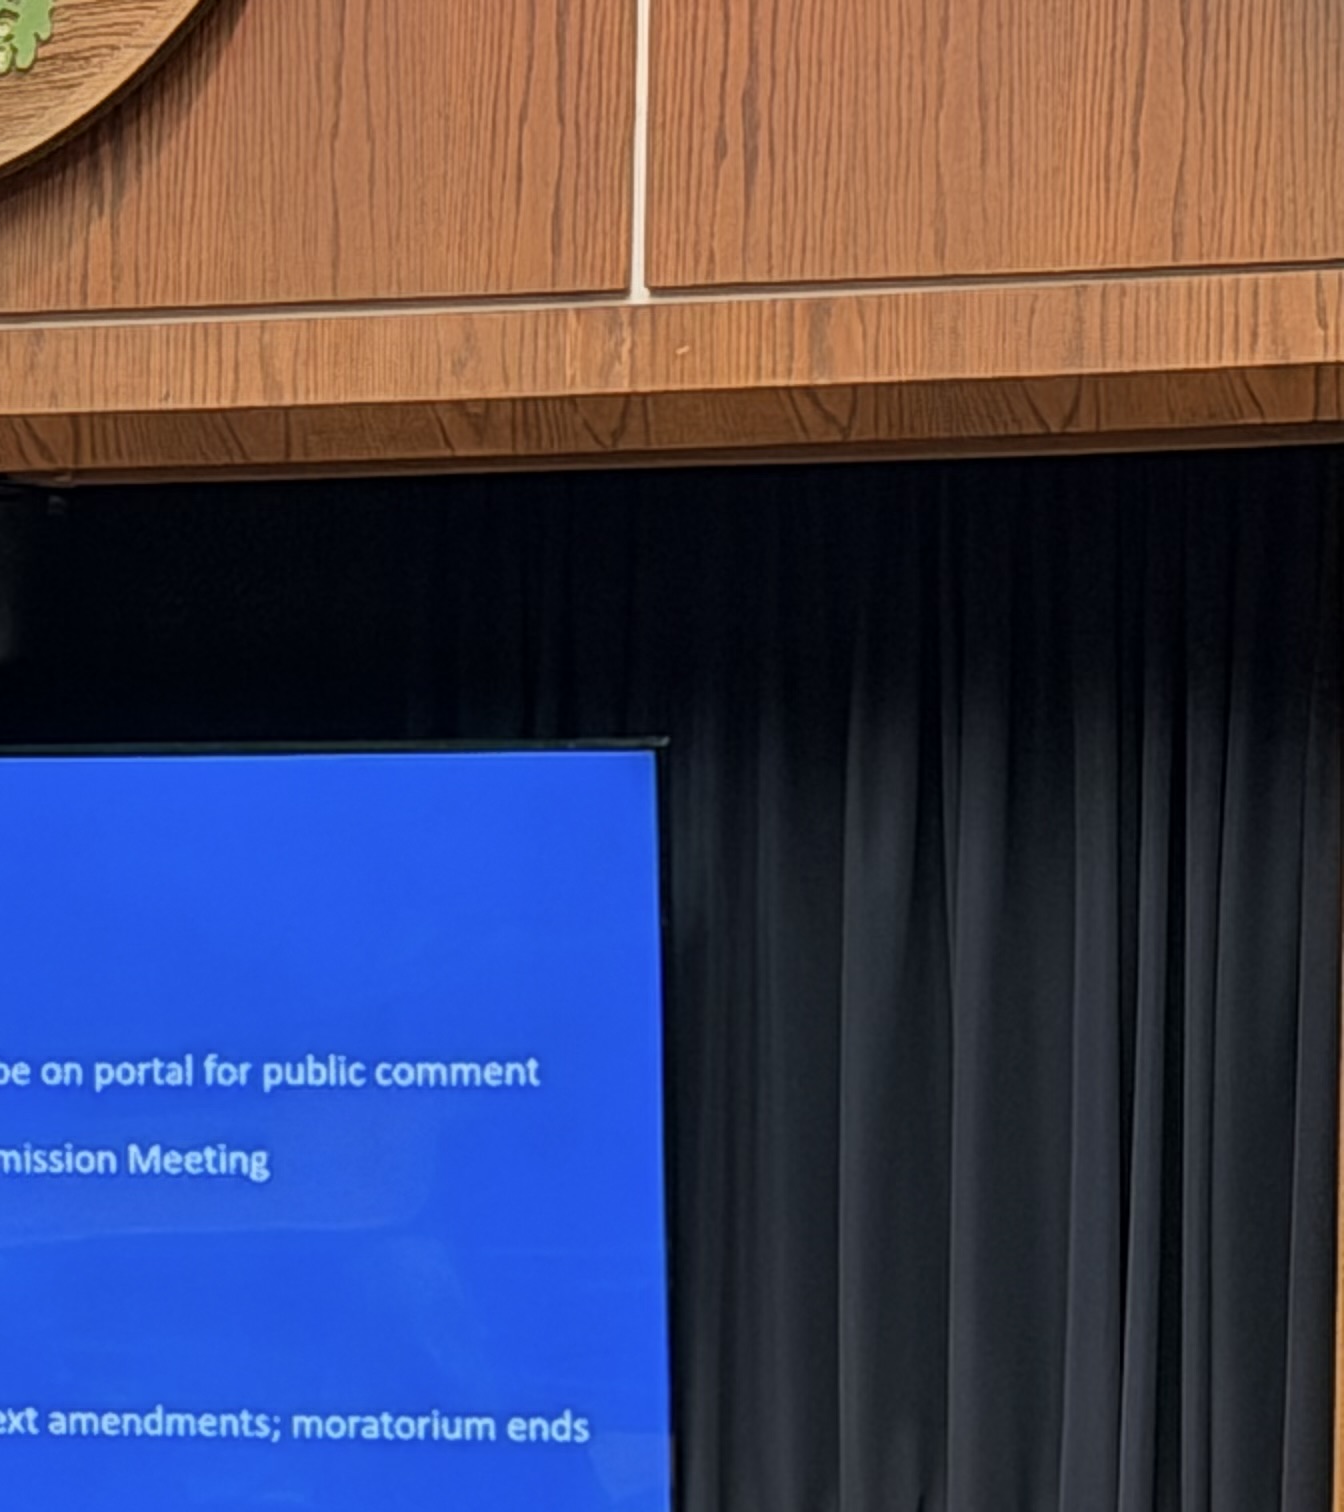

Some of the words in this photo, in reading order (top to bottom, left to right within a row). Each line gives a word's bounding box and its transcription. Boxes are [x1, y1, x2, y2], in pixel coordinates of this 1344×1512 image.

[40, 1061, 83, 1086] on
[94, 1053, 194, 1093] portal
[203, 1053, 253, 1087] for
[262, 1053, 366, 1093] public
[374, 1057, 541, 1087] comment
[127, 1143, 271, 1183] Meeting
[47, 1404, 281, 1443] amendments;
[292, 1409, 497, 1441] moratorium
[506, 1409, 590, 1443] ends
